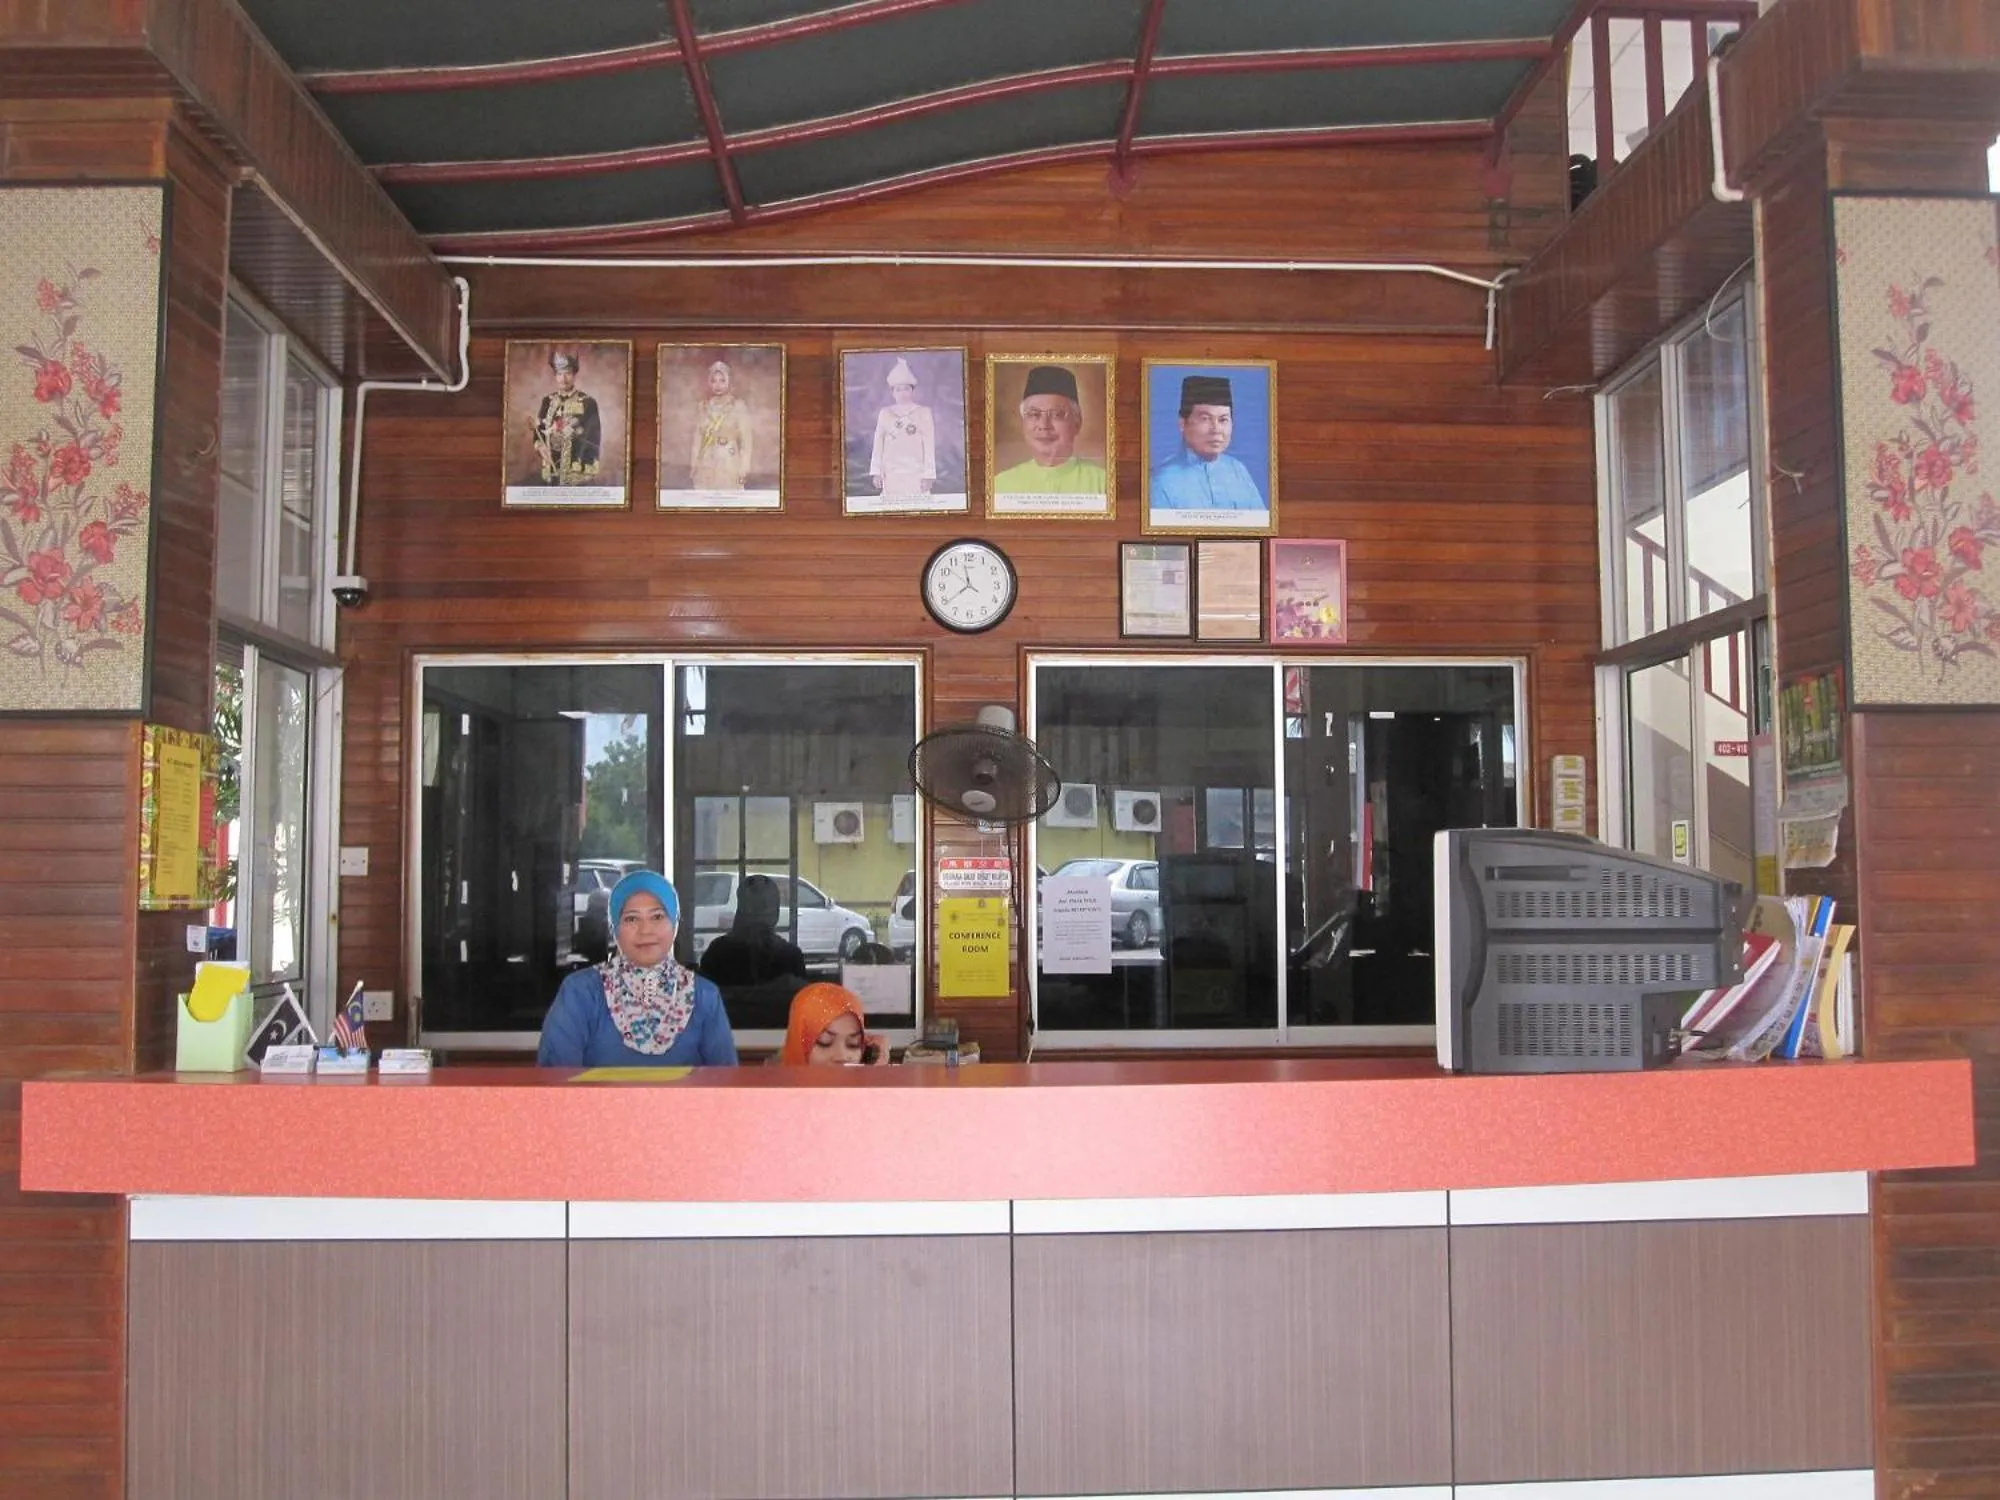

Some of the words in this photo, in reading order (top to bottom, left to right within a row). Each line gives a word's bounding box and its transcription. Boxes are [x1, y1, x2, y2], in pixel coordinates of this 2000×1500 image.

[949, 557, 958, 565] 11
[963, 553, 975, 562] 12
[940, 567, 950, 576] 10
[990, 566, 998, 575] 2
[938, 583, 946, 591] 9
[993, 581, 1001, 590] 3
[940, 596, 949, 605] 8
[991, 595, 998, 604] 4
[951, 607, 958, 616] 7
[966, 609, 974, 619] 6
[980, 606, 988, 615] 5
[948, 932, 1001, 940] CONFERENCE
[962, 945, 989, 953] ROOM
